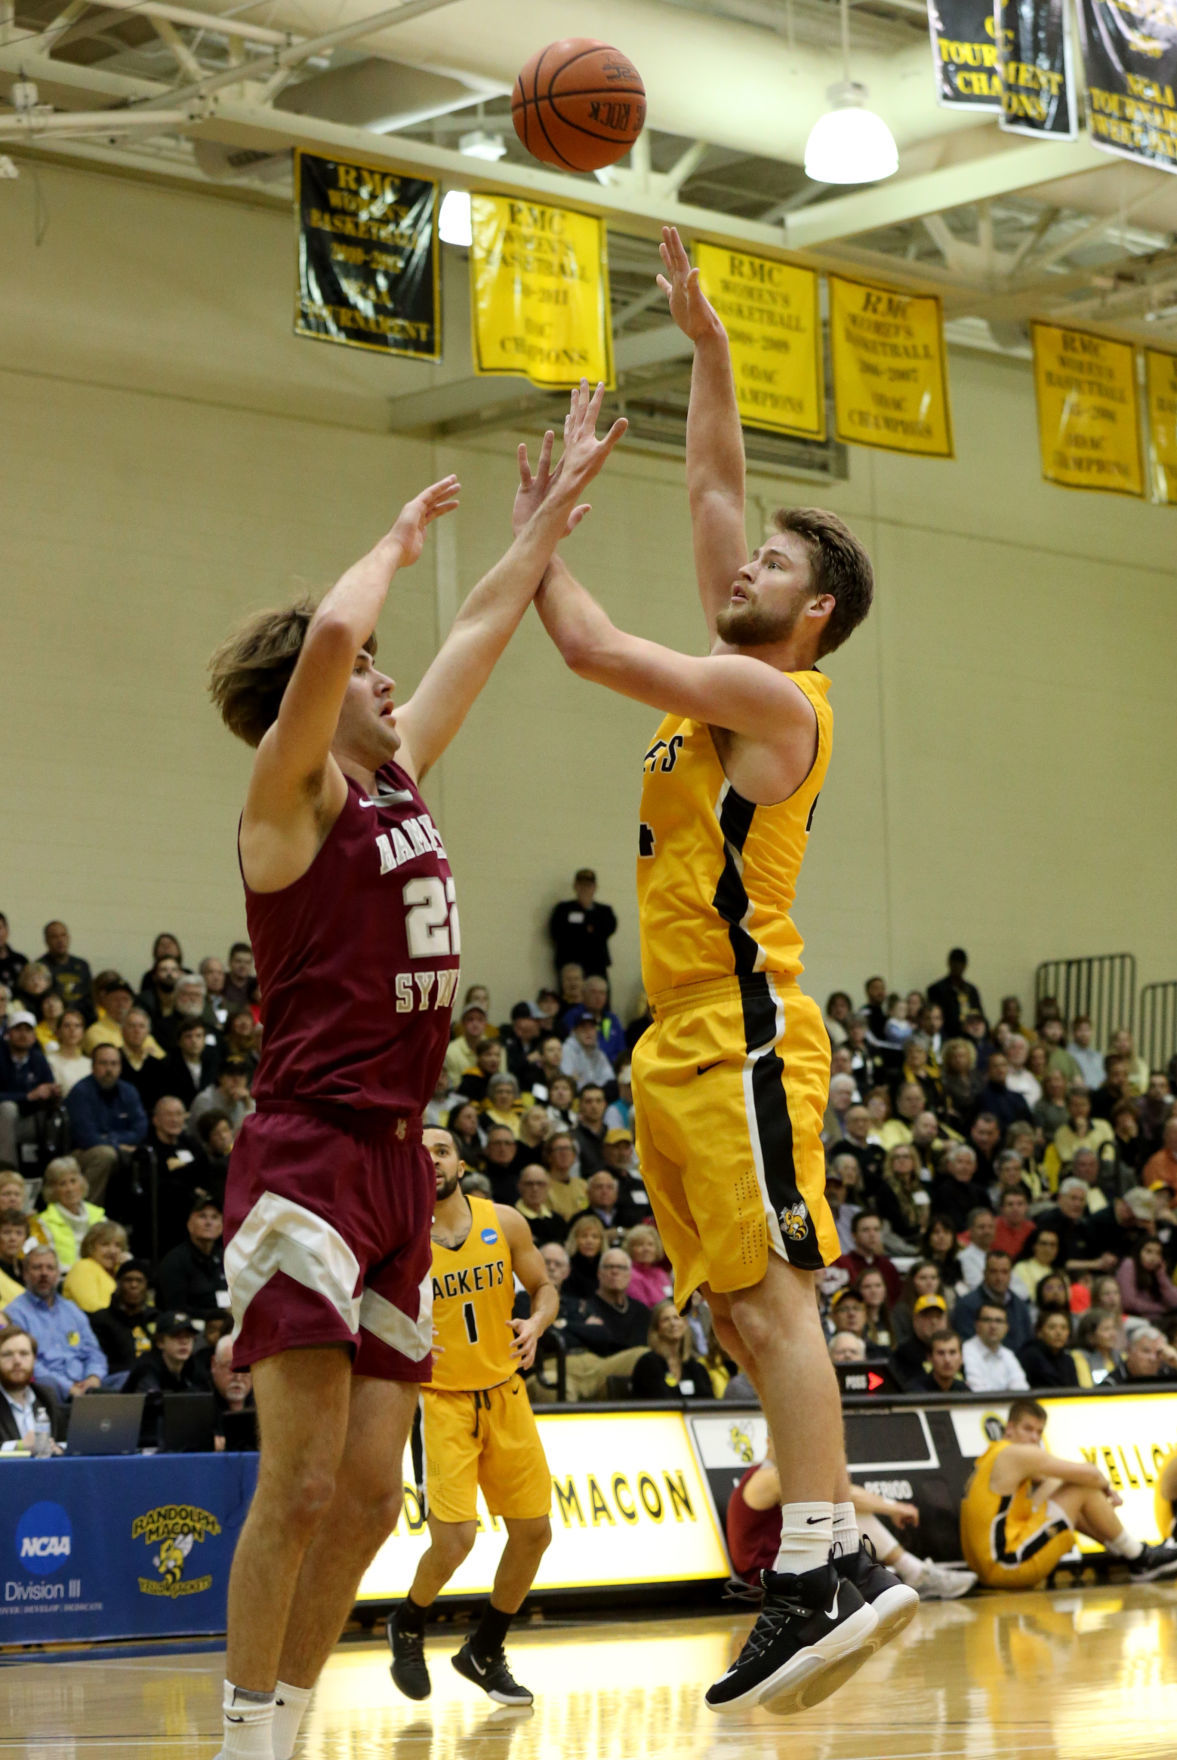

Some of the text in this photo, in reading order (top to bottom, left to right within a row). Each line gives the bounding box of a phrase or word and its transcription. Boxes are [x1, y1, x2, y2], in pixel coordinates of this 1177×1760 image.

[338, 164, 400, 199] RMC
[729, 254, 783, 285] RMC
[432, 1260, 504, 1301] ACKETS
[464, 1302, 479, 1345] 1
[552, 1474, 695, 1525] MACON
[20, 1535, 72, 1558] NCAA
[147, 1521, 203, 1542] MACON
[4, 1578, 82, 1601] Division III
